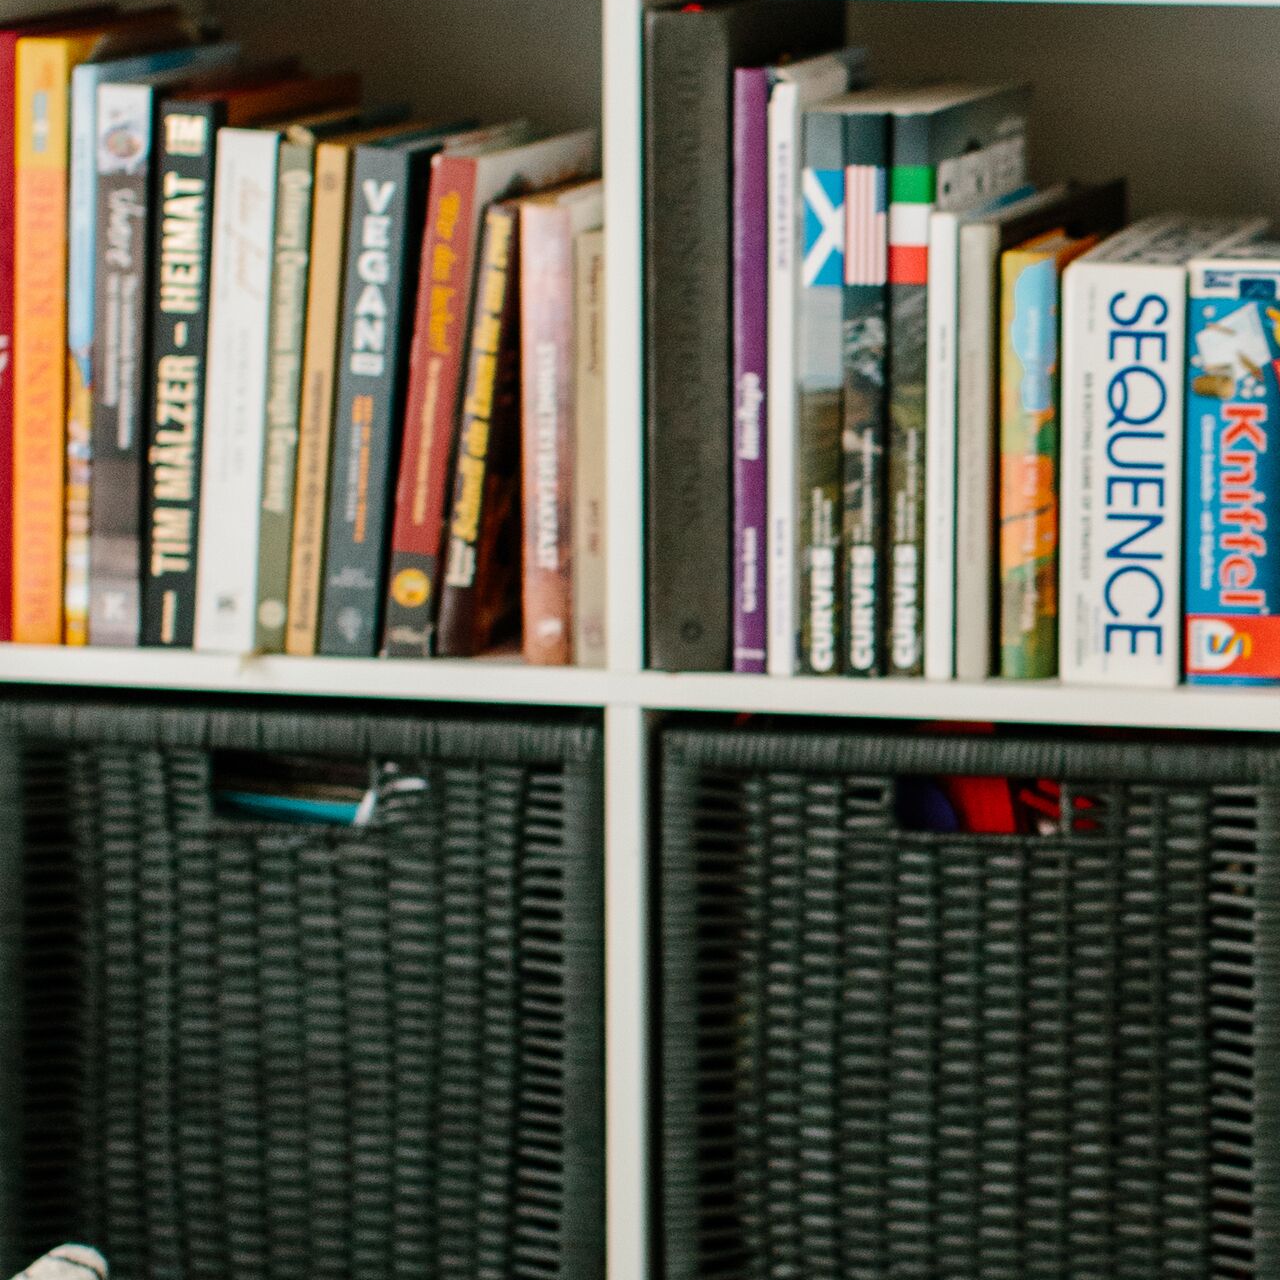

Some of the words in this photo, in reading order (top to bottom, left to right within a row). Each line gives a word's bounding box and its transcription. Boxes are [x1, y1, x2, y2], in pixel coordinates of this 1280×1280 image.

[160, 172, 202, 313] HEIMAT
[146, 355, 197, 502] MÄLZER
[1101, 290, 1169, 658] SEQUENCE
[150, 507, 190, 577] TIM
[1218, 403, 1267, 606] Kniffel
[810, 546, 834, 669] CURVES
[851, 545, 875, 668] CURVES
[894, 544, 916, 667] CURVES
